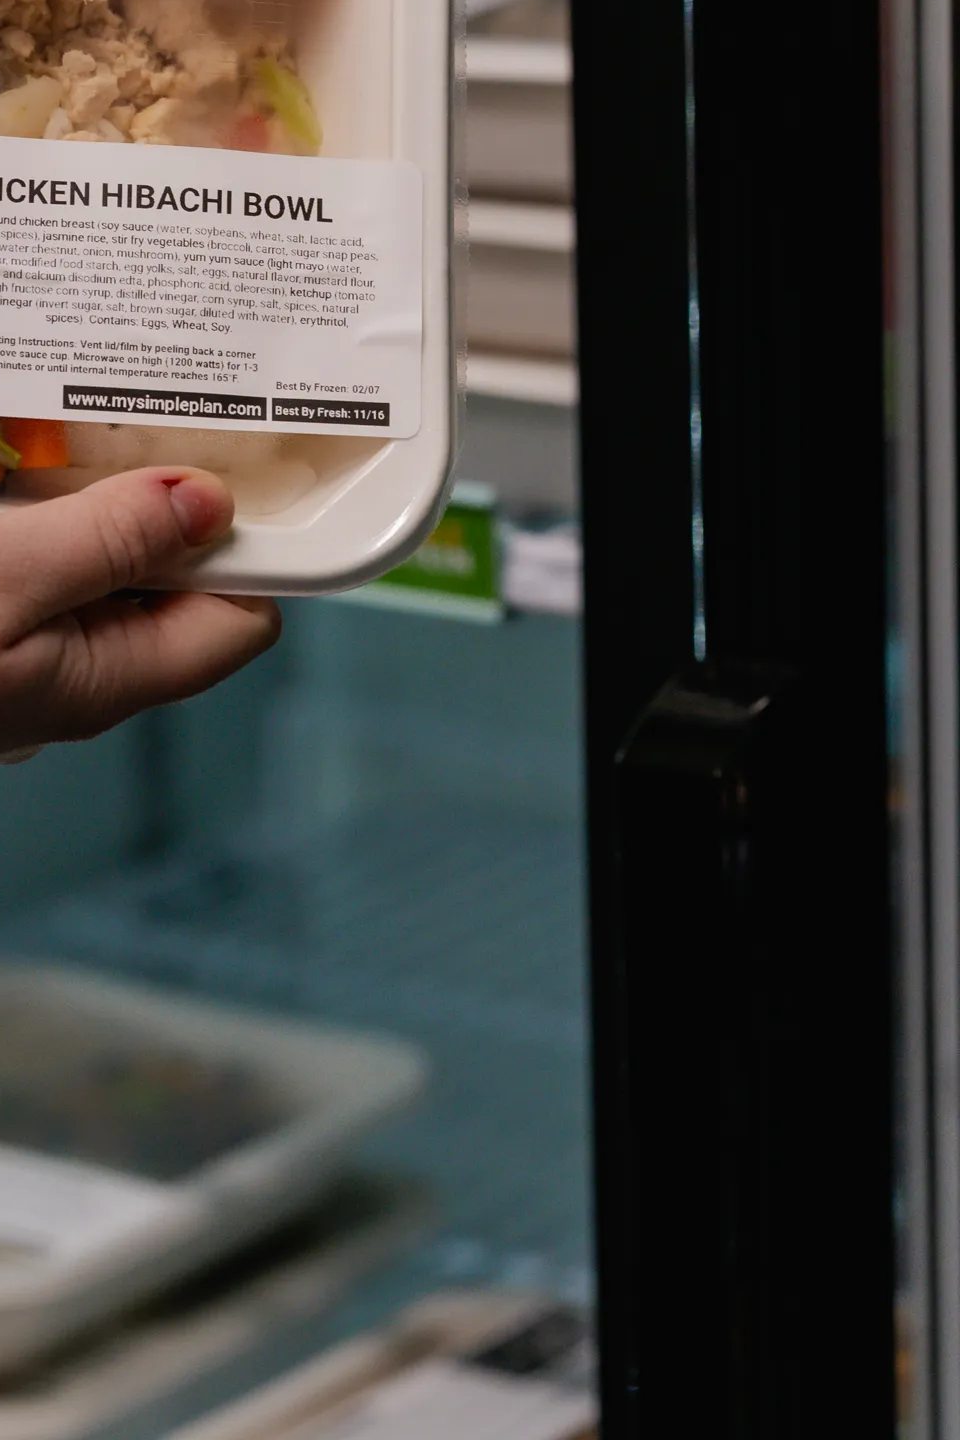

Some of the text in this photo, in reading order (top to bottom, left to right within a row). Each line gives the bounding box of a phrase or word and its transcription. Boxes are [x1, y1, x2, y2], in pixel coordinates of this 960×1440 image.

[101, 182, 232, 215] HIBACHI
[243, 191, 333, 223] BOWL
[0, 230, 40, 241] spices),
[41, 230, 84, 243] jasmine
[86, 234, 108, 244] rice,
[111, 234, 128, 244] stir
[130, 235, 144, 248] fry
[146, 237, 205, 249] vegetables
[206, 240, 253, 253] (broccoli,
[255, 245, 288, 256] carrot,
[290, 248, 320, 260] sugar
[322, 251, 348, 262] snap
[349, 252, 378, 262] peas,
[18, 216, 58, 227] chicken
[60, 218, 95, 229] breast
[96, 222, 120, 233] (soy
[121, 224, 154, 232] sauce
[156, 224, 192, 236] (water,
[194, 227, 247, 241] soybeans,
[249, 231, 284, 242] wheat,
[286, 233, 307, 244] salt,
[309, 234, 337, 246] lactic
[339, 237, 364, 248] acid,
[10, 256, 57, 268] modified
[59, 258, 83, 269] food
[85, 260, 121, 272] starch,
[123, 264, 144, 275] egg
[145, 263, 175, 275] yolks,
[177, 265, 199, 276] salt,
[201, 268, 229, 279] eggs,
[232, 270, 269, 281] natural
[270, 272, 301, 284] flavor,
[303, 275, 348, 286] mustard
[350, 276, 375, 288] flour,
[31, 243, 80, 256] chestnut,
[82, 248, 114, 258] onion,
[116, 249, 180, 261] mushroom),
[183, 253, 206, 266] yum
[208, 255, 231, 265] yum
[233, 257, 265, 267] sauce
[266, 257, 293, 271] (light
[294, 262, 324, 273] mayo
[326, 264, 362, 275] (water,
[2, 268, 23, 279] and
[24, 270, 66, 282] calcium
[68, 271, 116, 284] disodium
[118, 275, 145, 287] edta,
[147, 276, 205, 290] phosphoric
[208, 280, 232, 292] acid,
[234, 282, 287, 297] oleoresin),
[289, 286, 332, 301] ketchup
[333, 290, 375, 301] (tomato
[11, 282, 53, 294] fructose
[55, 287, 79, 296] corn
[81, 288, 113, 300] syrup,
[115, 289, 156, 300] distilled
[158, 293, 199, 304] vinegar,
[201, 296, 224, 305] corn
[227, 297, 258, 309] syrup,
[259, 298, 281, 310] salt,
[283, 300, 319, 313] spices,
[321, 303, 359, 314] natural
[35, 298, 68, 309] (invert
[71, 301, 103, 313] sugar,
[105, 302, 127, 313] salt,
[129, 303, 163, 314] brown
[165, 307, 197, 319] sugar,
[199, 307, 235, 319] diluted
[236, 310, 259, 321] with
[260, 314, 297, 325] water),
[299, 315, 348, 328] erythritol,
[88, 314, 232, 335] Contains: Eggs, Wheat, Soy.
[18, 336, 77, 348] Instructions:
[79, 339, 102, 350] Vent
[104, 340, 138, 351] lid/film
[140, 342, 152, 354] by
[154, 344, 190, 356] peeling
[191, 345, 214, 356] back
[217, 349, 223, 357] a
[19, 350, 48, 359] sauce
[73, 351, 125, 363] Microwave
[127, 356, 139, 364] on
[141, 355, 162, 367] high
[164, 356, 193, 368] (1200
[195, 360, 224, 371] watts)
[226, 360, 241, 371] for
[243, 362, 258, 372] 1-3
[47, 363, 68, 373] until
[70, 364, 107, 375] internal
[108, 366, 168, 379] temperature
[170, 370, 208, 381] reaches
[275, 380, 380, 394] Best By Frozen: 02/07
[67, 393, 261, 417] www.mysimpleplan.com
[274, 405, 385, 420] Best By Fresh: 11/16
